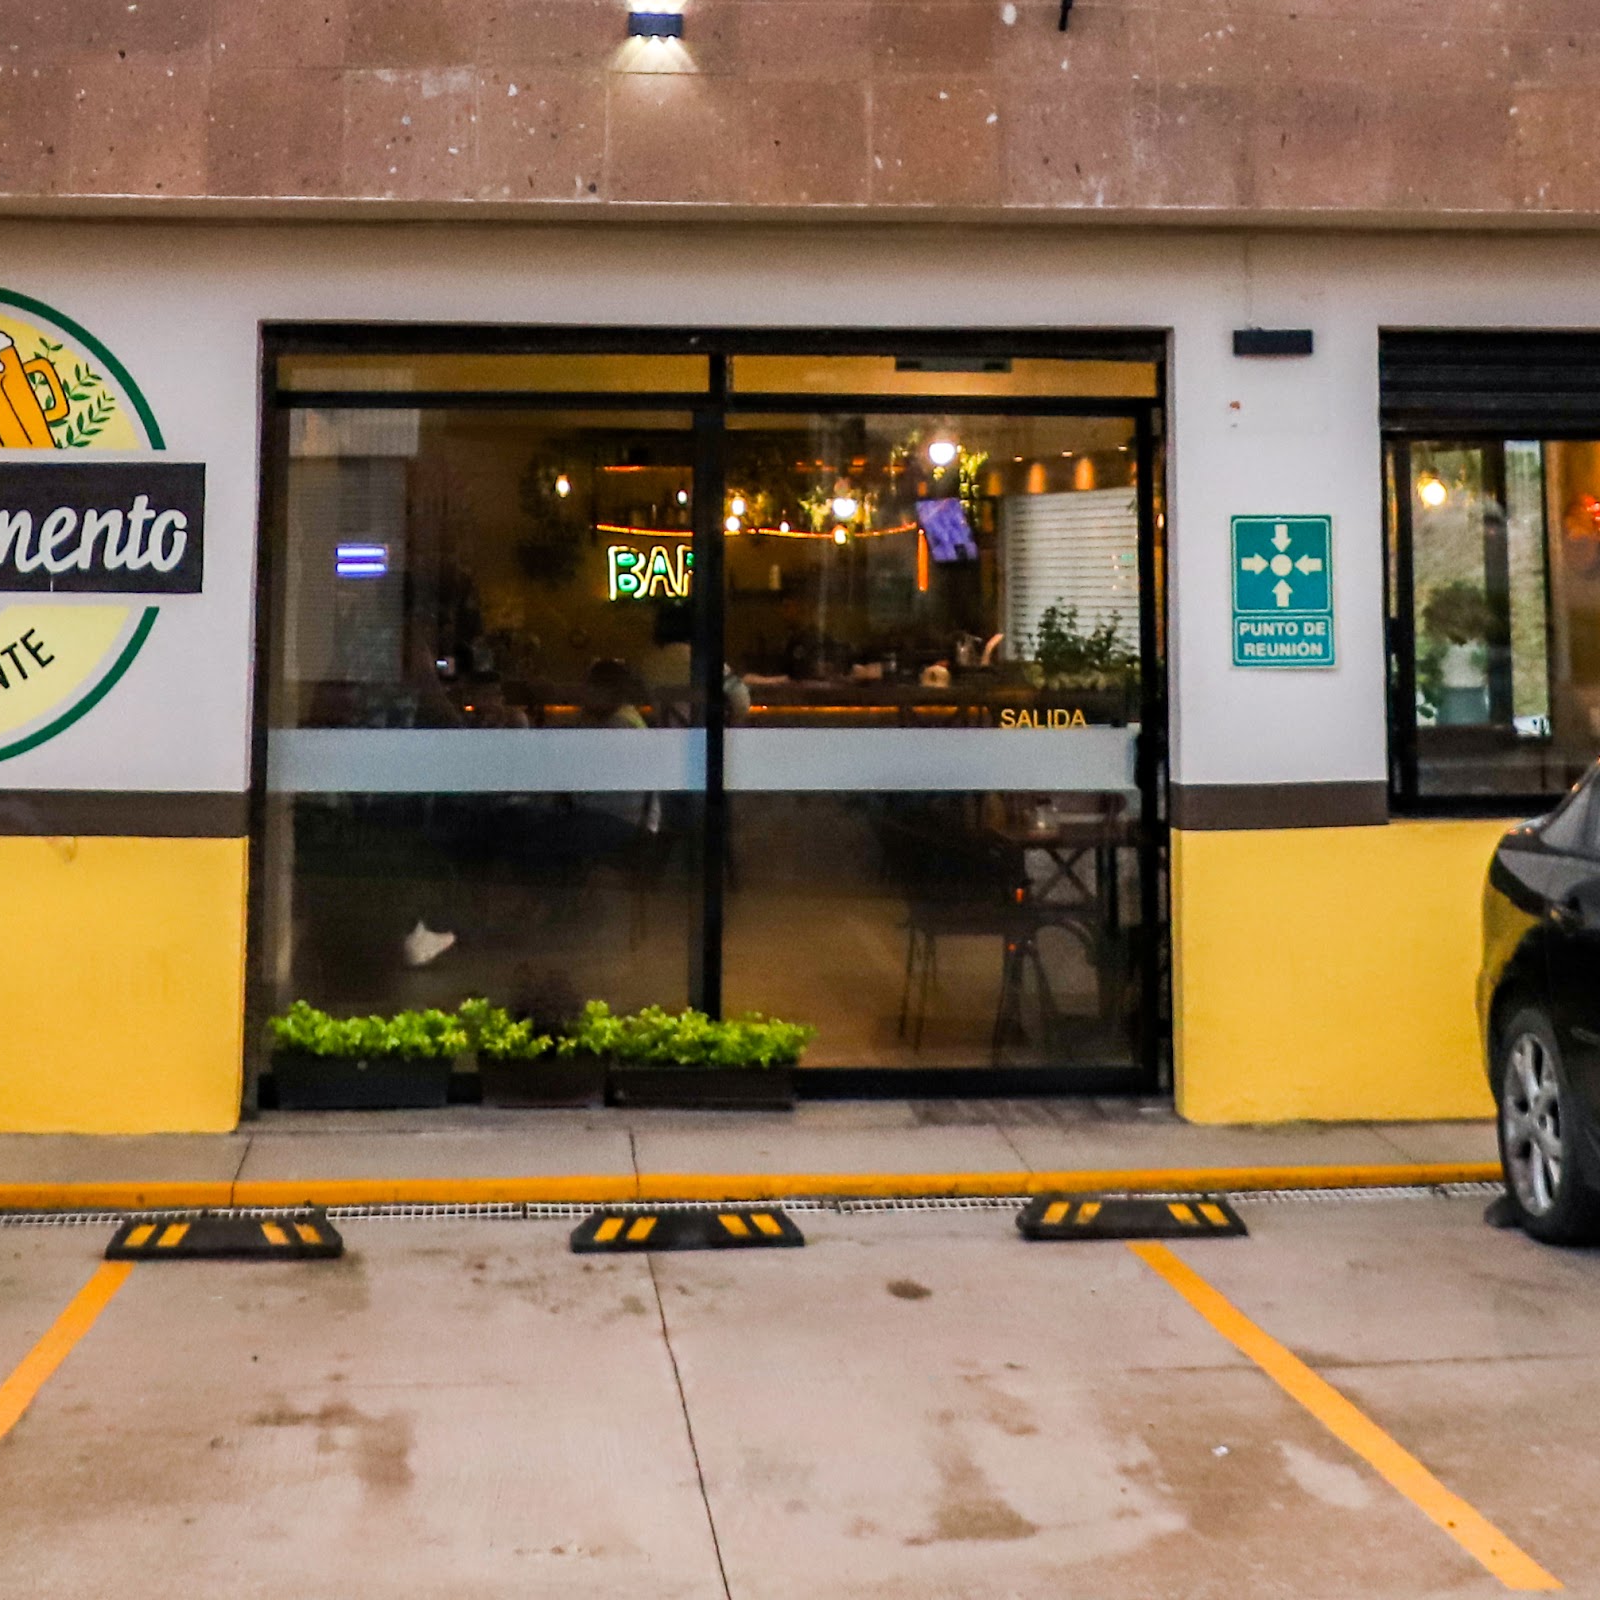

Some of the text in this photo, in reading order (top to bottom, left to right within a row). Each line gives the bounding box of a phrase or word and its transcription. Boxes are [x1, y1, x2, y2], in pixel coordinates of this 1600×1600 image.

[1239, 621, 1326, 636] PUNTO DE
[1243, 640, 1324, 657] REUNIÓN
[1000, 708, 1088, 729] SALIDA
